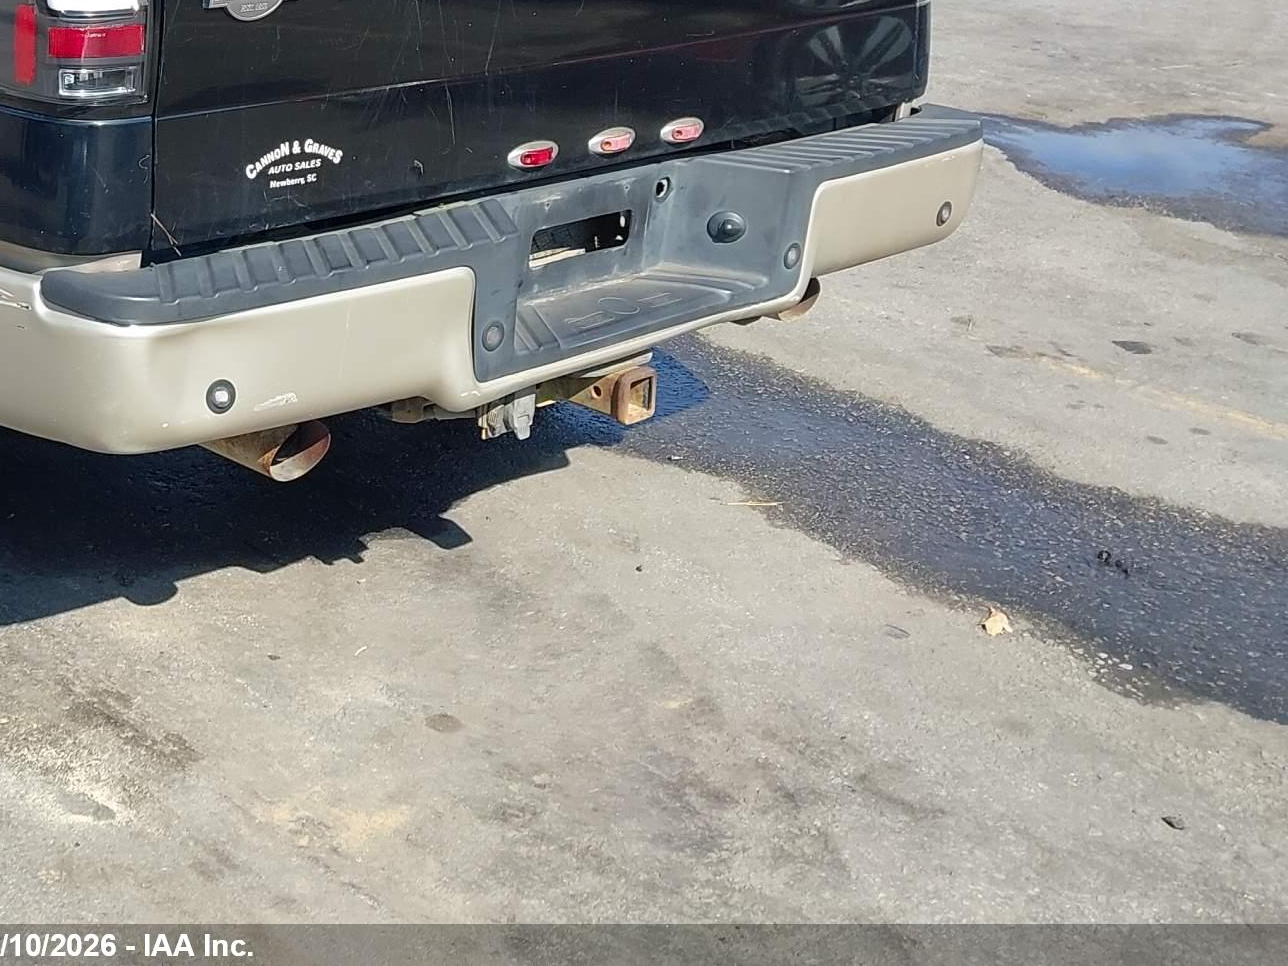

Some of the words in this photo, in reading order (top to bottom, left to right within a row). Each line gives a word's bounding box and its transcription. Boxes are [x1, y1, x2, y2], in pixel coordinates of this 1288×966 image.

[292, 140, 301, 154] &
[268, 163, 293, 175] AUTO
[294, 158, 322, 171] SALES
[306, 173, 317, 183] SC
